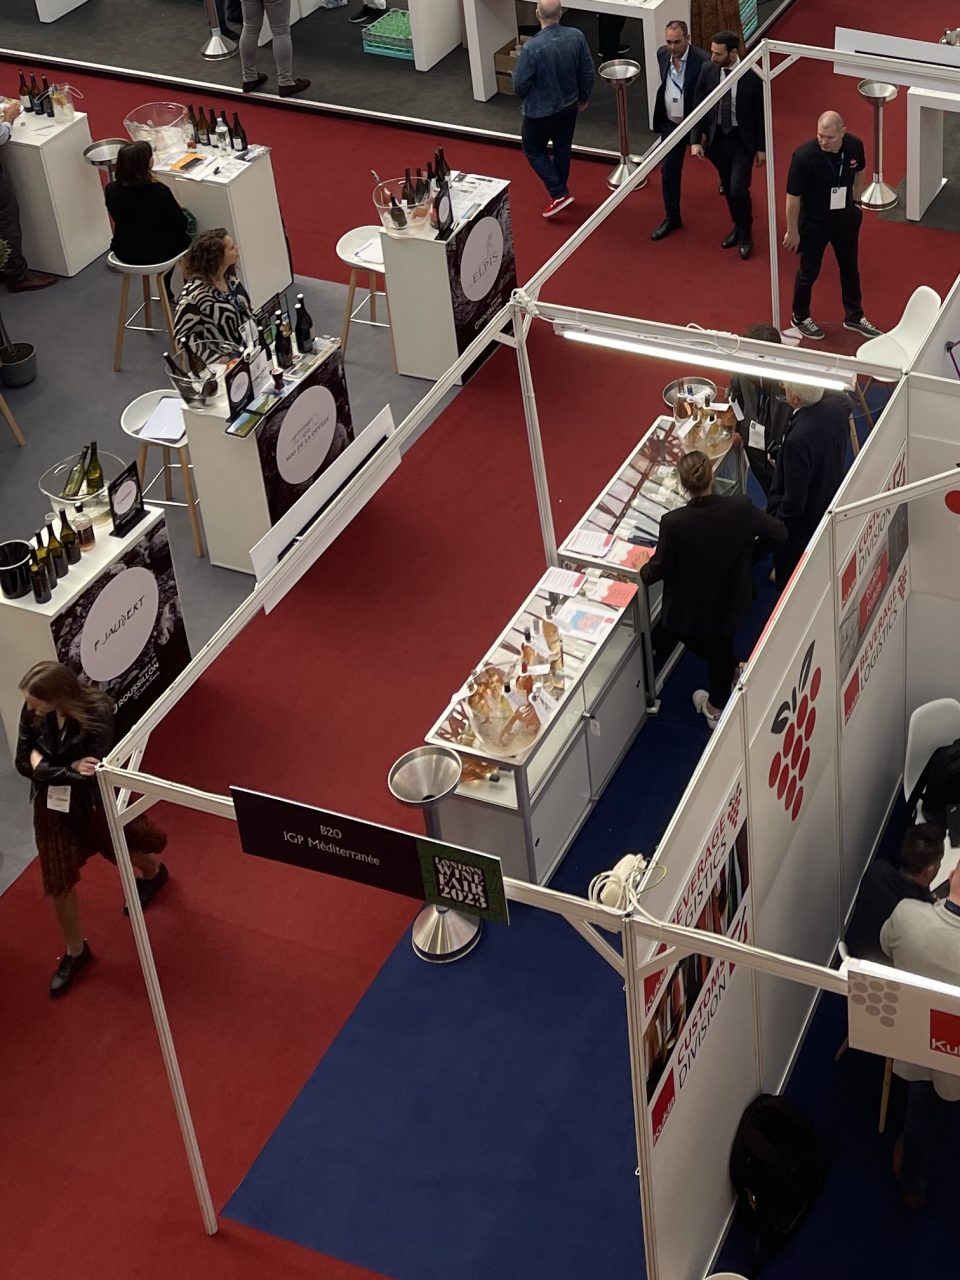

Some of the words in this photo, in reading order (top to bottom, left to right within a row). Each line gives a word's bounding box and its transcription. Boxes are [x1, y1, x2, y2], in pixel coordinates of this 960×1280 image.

[472, 254, 498, 284] ELPIS
[859, 587, 898, 671] BEVERAGE
[861, 606, 898, 691] LOGISTICS
[283, 831, 304, 845] IGP
[308, 837, 380, 866] Méditerranée
[435, 857, 482, 874] LONDON
[437, 863, 484, 885] WINE
[438, 874, 484, 896] FAIR
[683, 834, 727, 927] GISTICS
[439, 886, 488, 909] 2023
[677, 959, 726, 1065] CUSTOMS
[679, 974, 727, 1089] DIVISION
